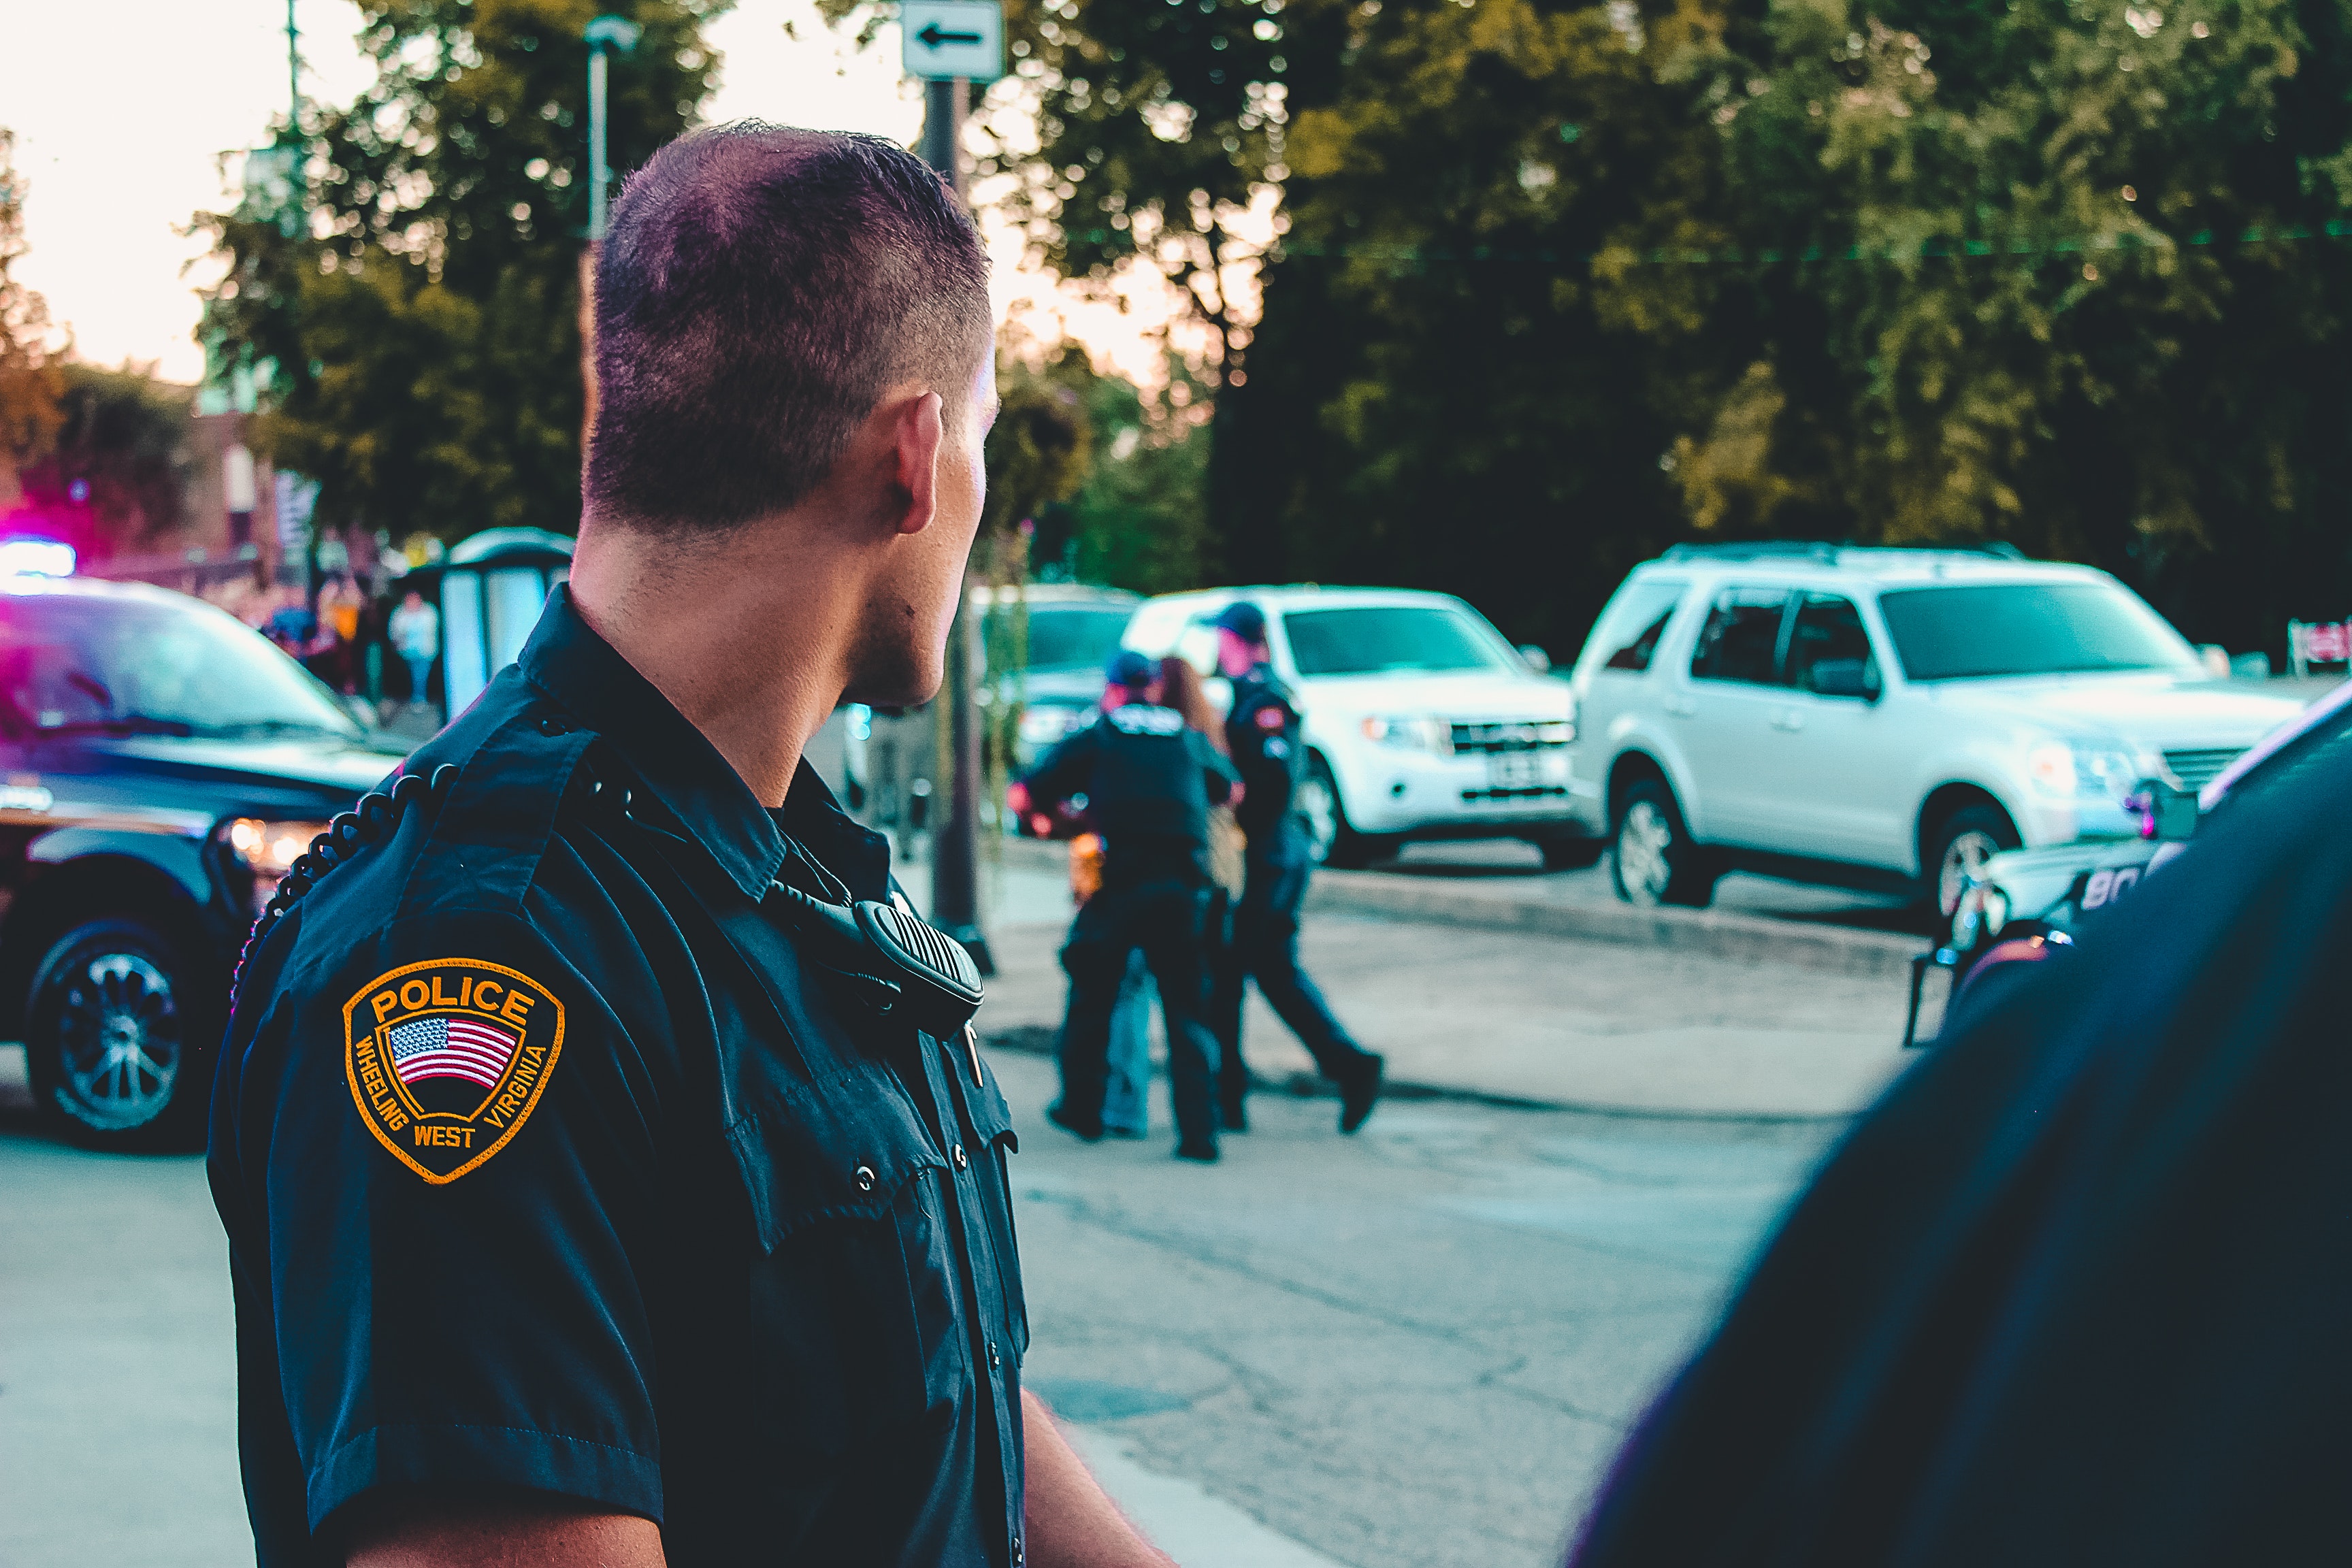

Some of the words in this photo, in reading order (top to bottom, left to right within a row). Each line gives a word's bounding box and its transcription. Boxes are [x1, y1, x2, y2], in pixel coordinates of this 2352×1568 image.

[371, 977, 534, 1026] POLICE
[356, 1036, 409, 1131] WHEELING
[414, 1126, 475, 1147] WEST
[484, 1047, 546, 1128] VIRGINIA
